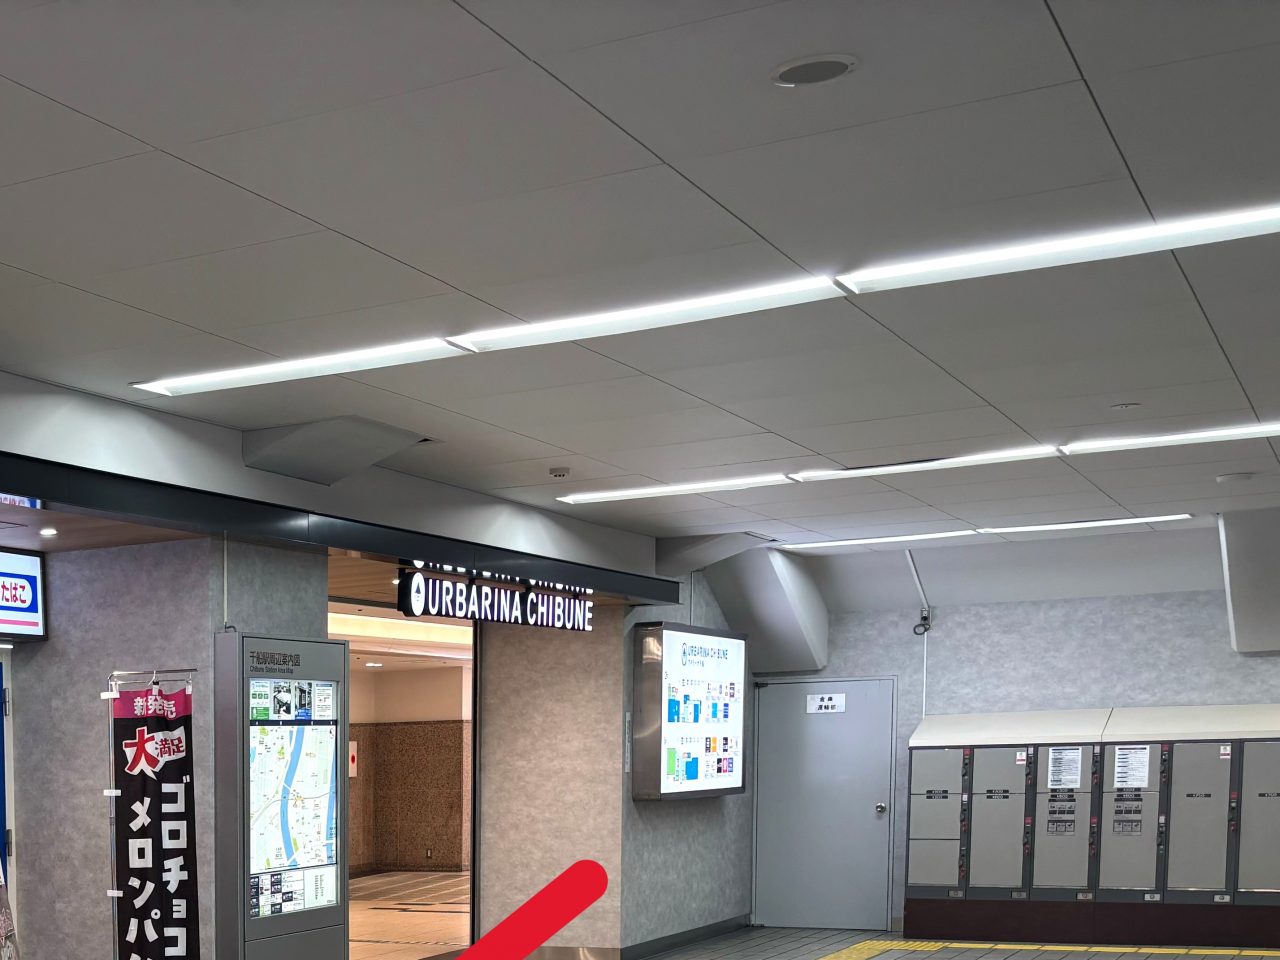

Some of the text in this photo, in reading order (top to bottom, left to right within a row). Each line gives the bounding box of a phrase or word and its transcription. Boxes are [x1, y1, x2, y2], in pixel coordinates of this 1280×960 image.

[428, 578, 594, 632] URBARINA CHIBUNE
[133, 695, 177, 719] 新発売
